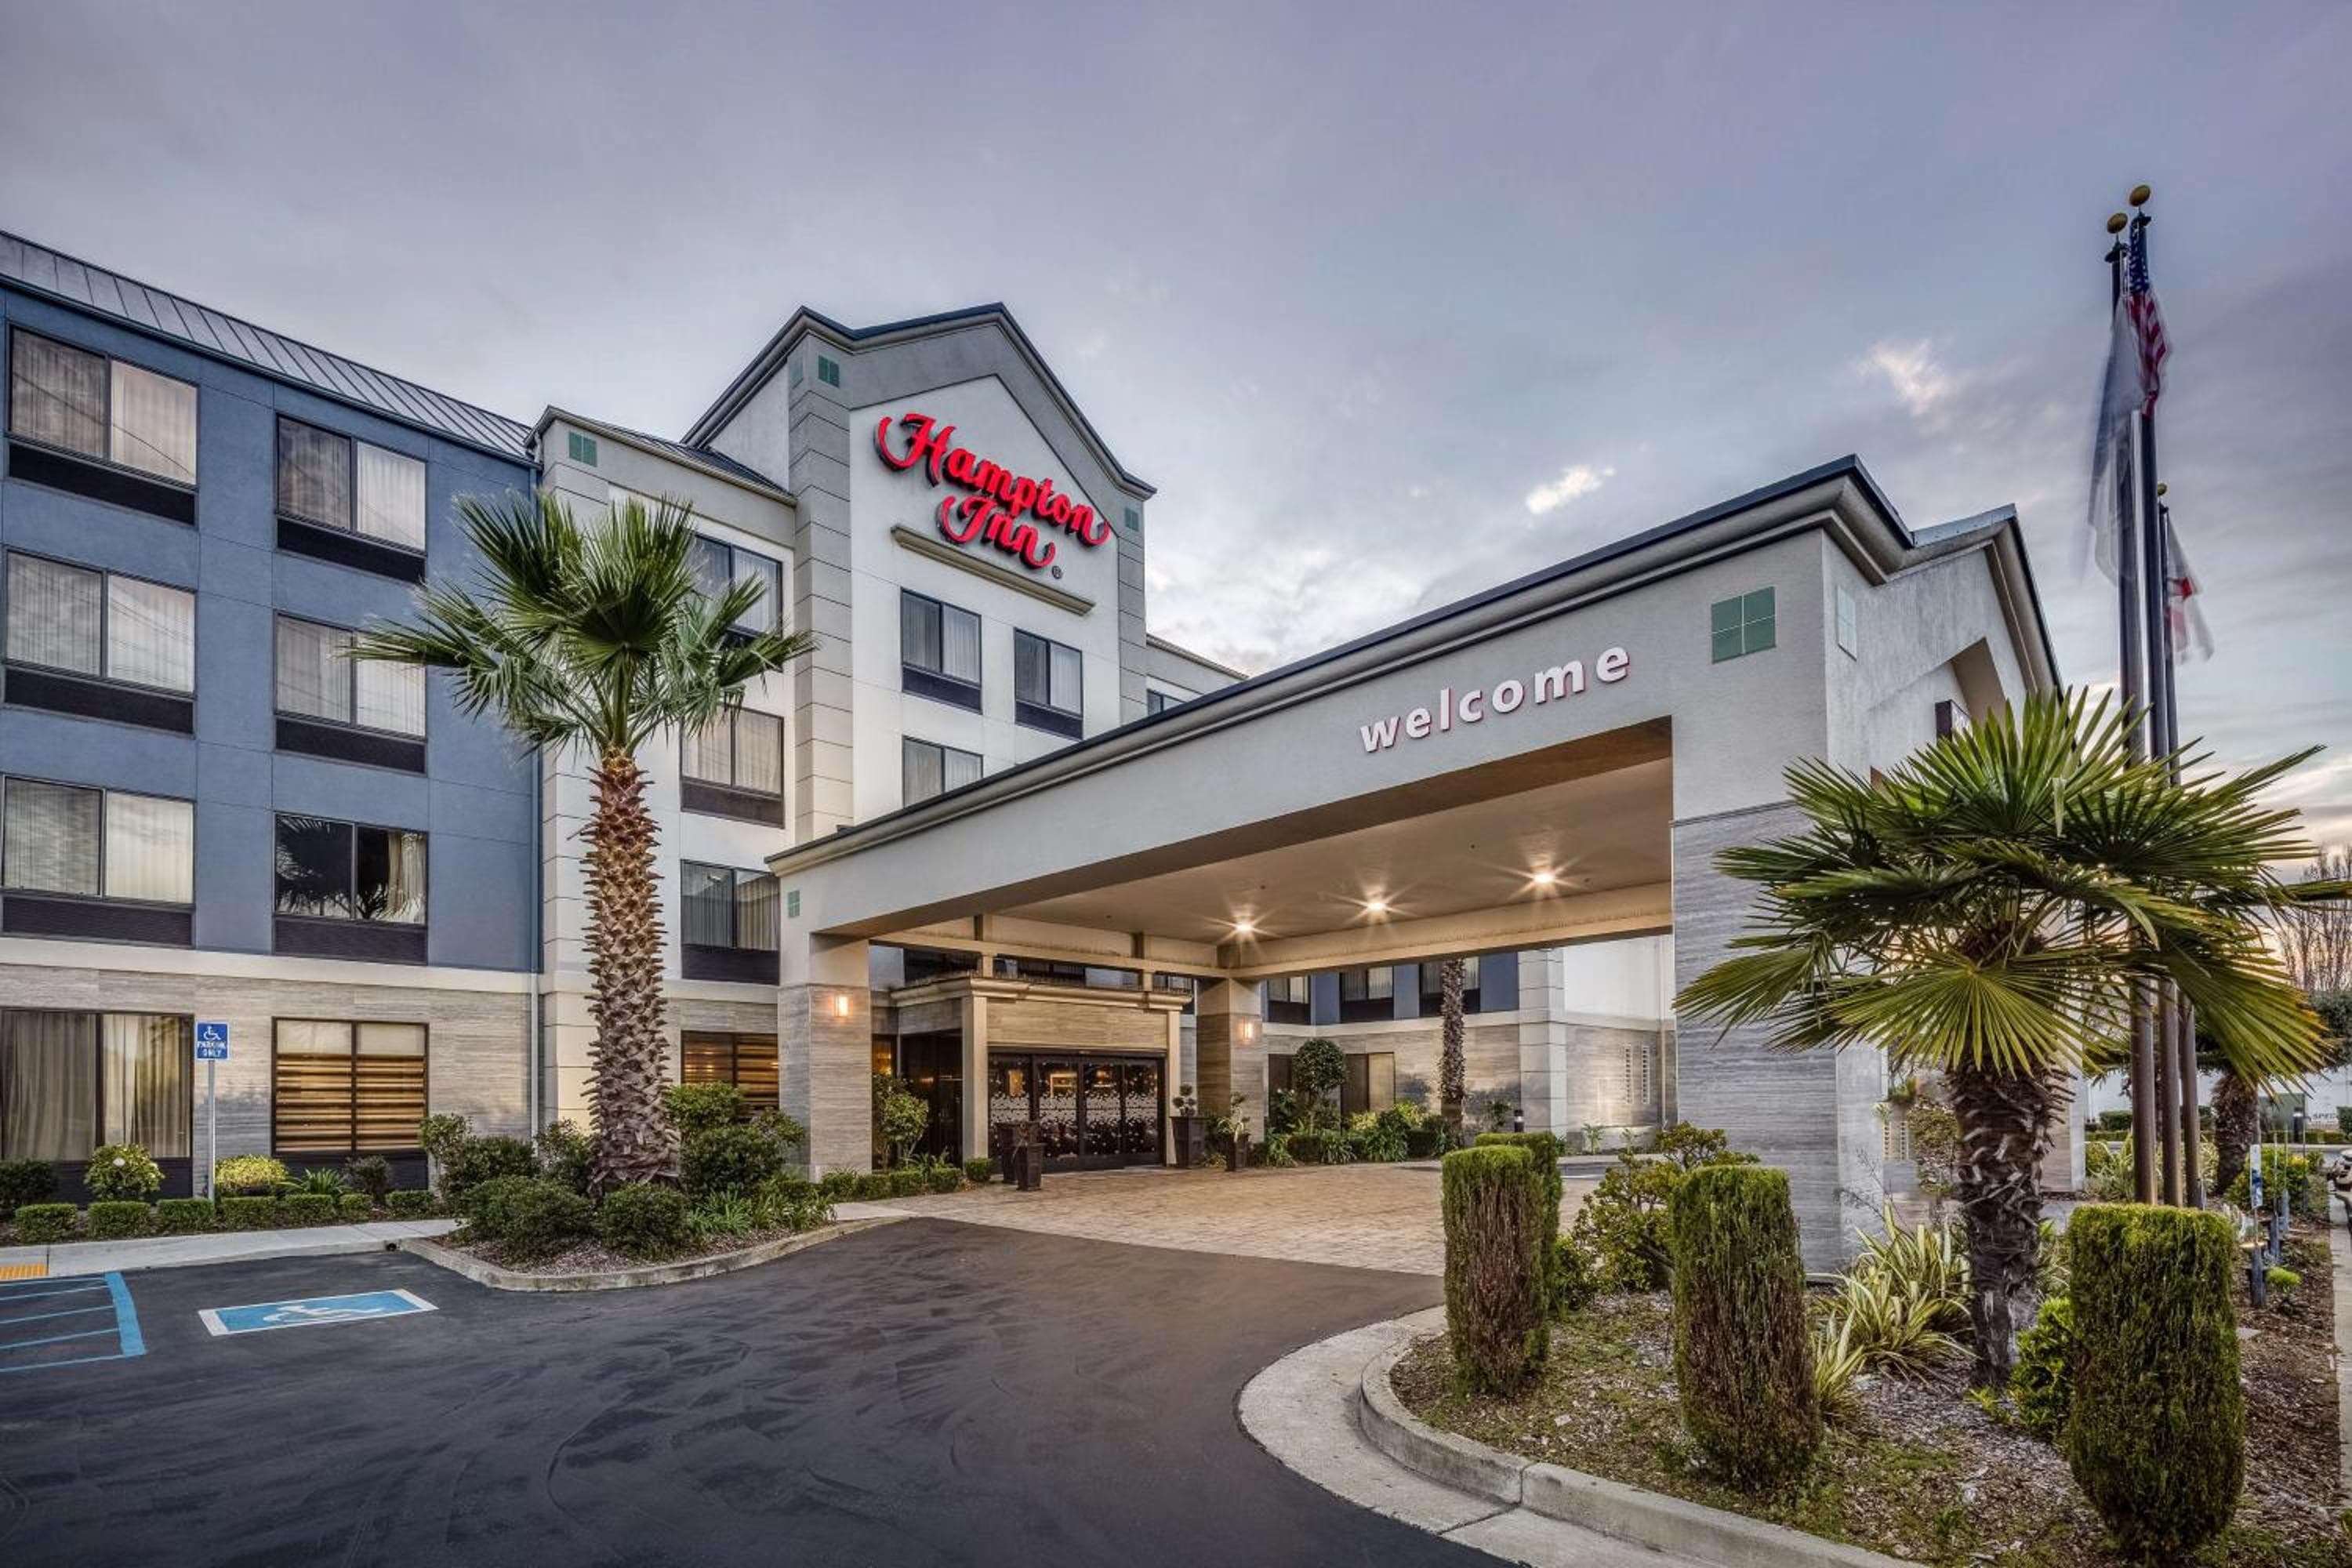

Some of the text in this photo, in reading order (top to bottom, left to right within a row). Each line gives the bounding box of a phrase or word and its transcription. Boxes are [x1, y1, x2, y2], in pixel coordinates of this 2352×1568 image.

[873, 412, 1111, 547] Hampton
[937, 495, 1056, 569] Inn
[1359, 646, 1630, 753] welcome
